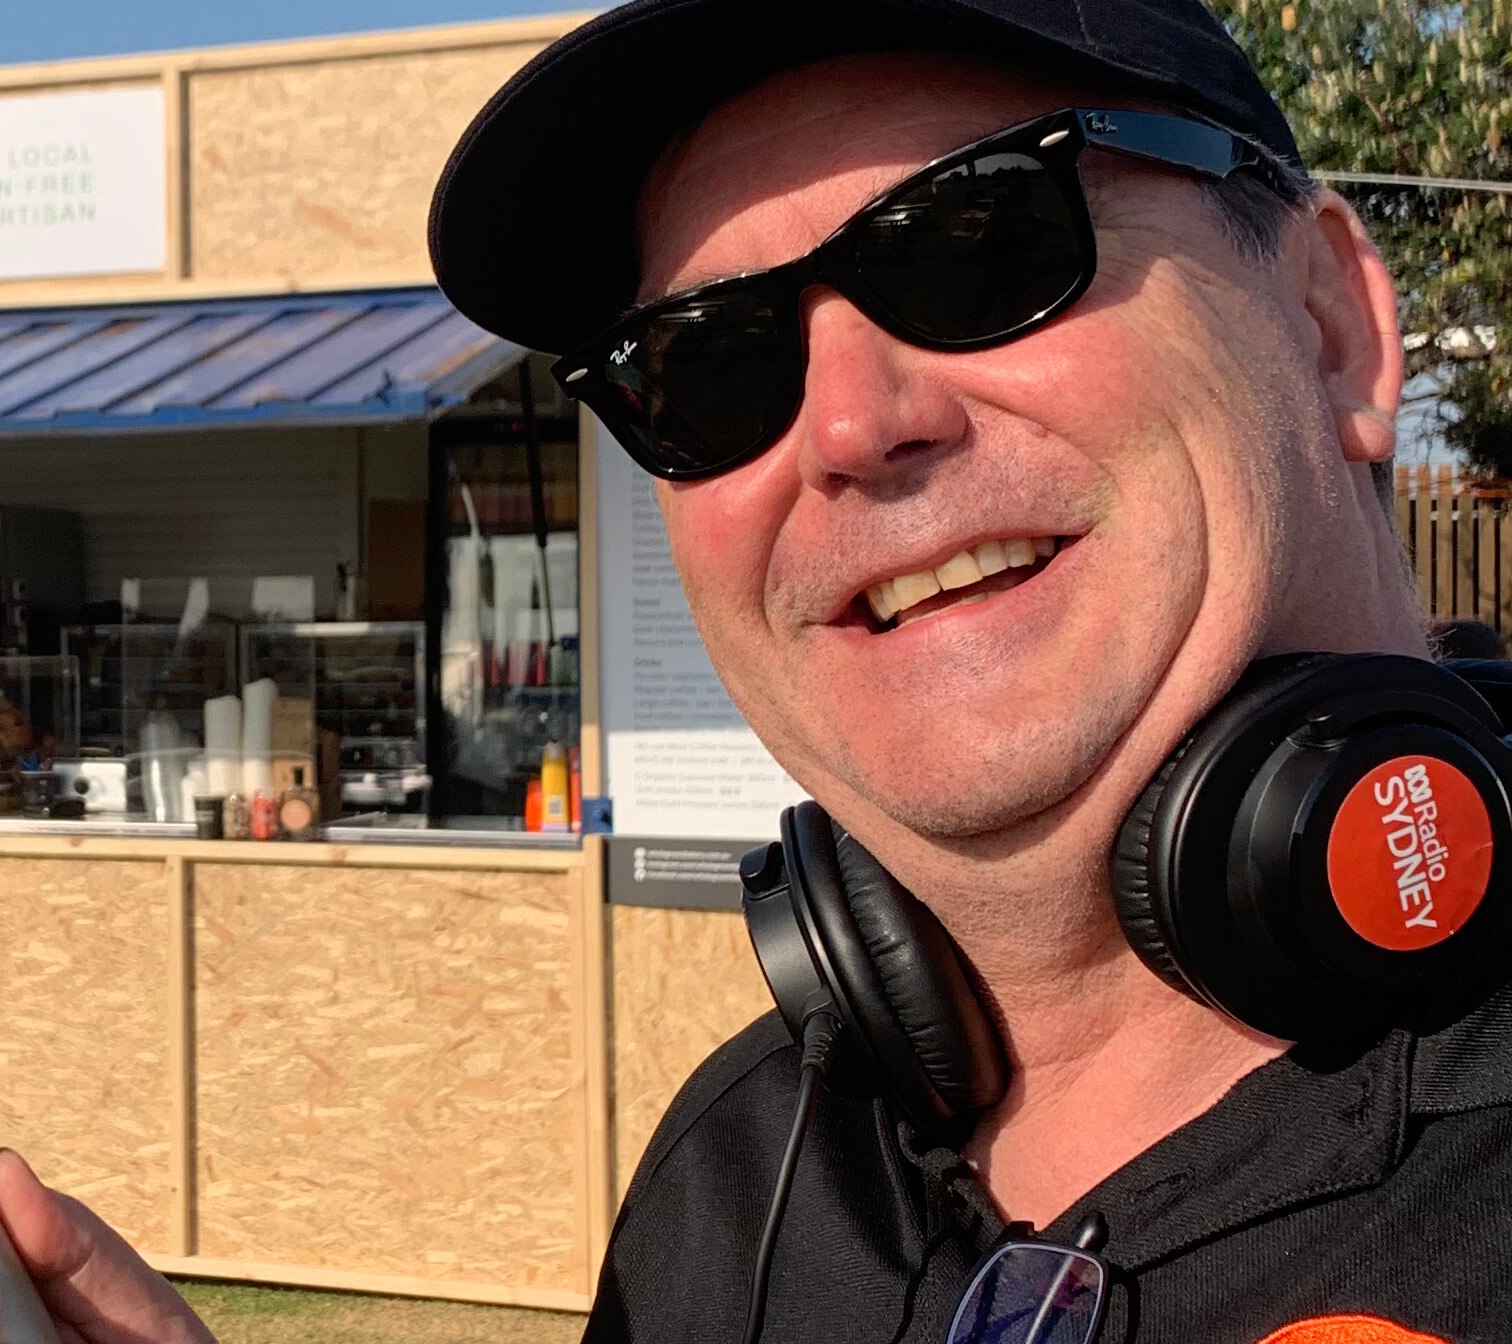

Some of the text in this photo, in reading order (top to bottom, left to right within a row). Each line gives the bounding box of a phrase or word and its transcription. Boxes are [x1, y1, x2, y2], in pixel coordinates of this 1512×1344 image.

[7, 142, 93, 170] LOCAL
[24, 171, 94, 197] FREE
[1374, 774, 1438, 930] SYDNEY
[1414, 800, 1449, 883] Radio
